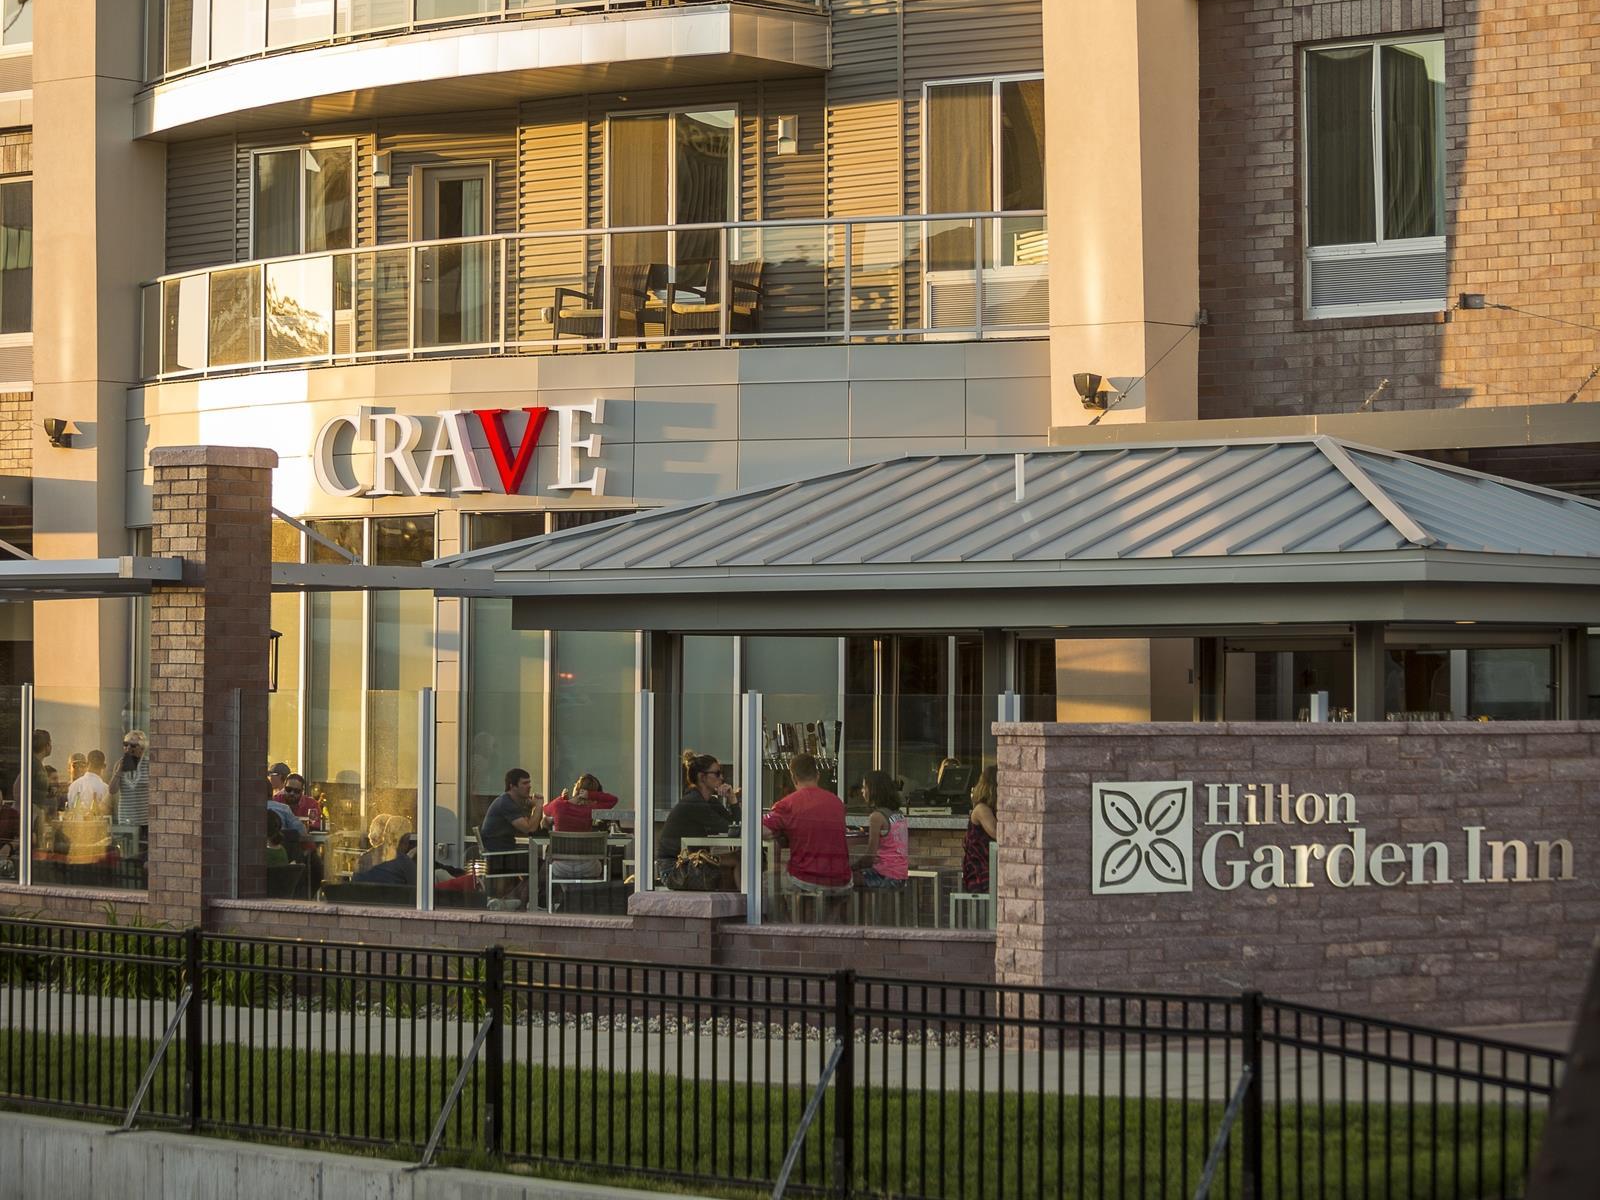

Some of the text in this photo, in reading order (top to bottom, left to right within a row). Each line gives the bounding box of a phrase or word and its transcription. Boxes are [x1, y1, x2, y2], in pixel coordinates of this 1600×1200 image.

[313, 398, 607, 497] CRAVE
[1204, 783, 1359, 825] Hilton
[1201, 826, 1576, 891] Garden Inn
